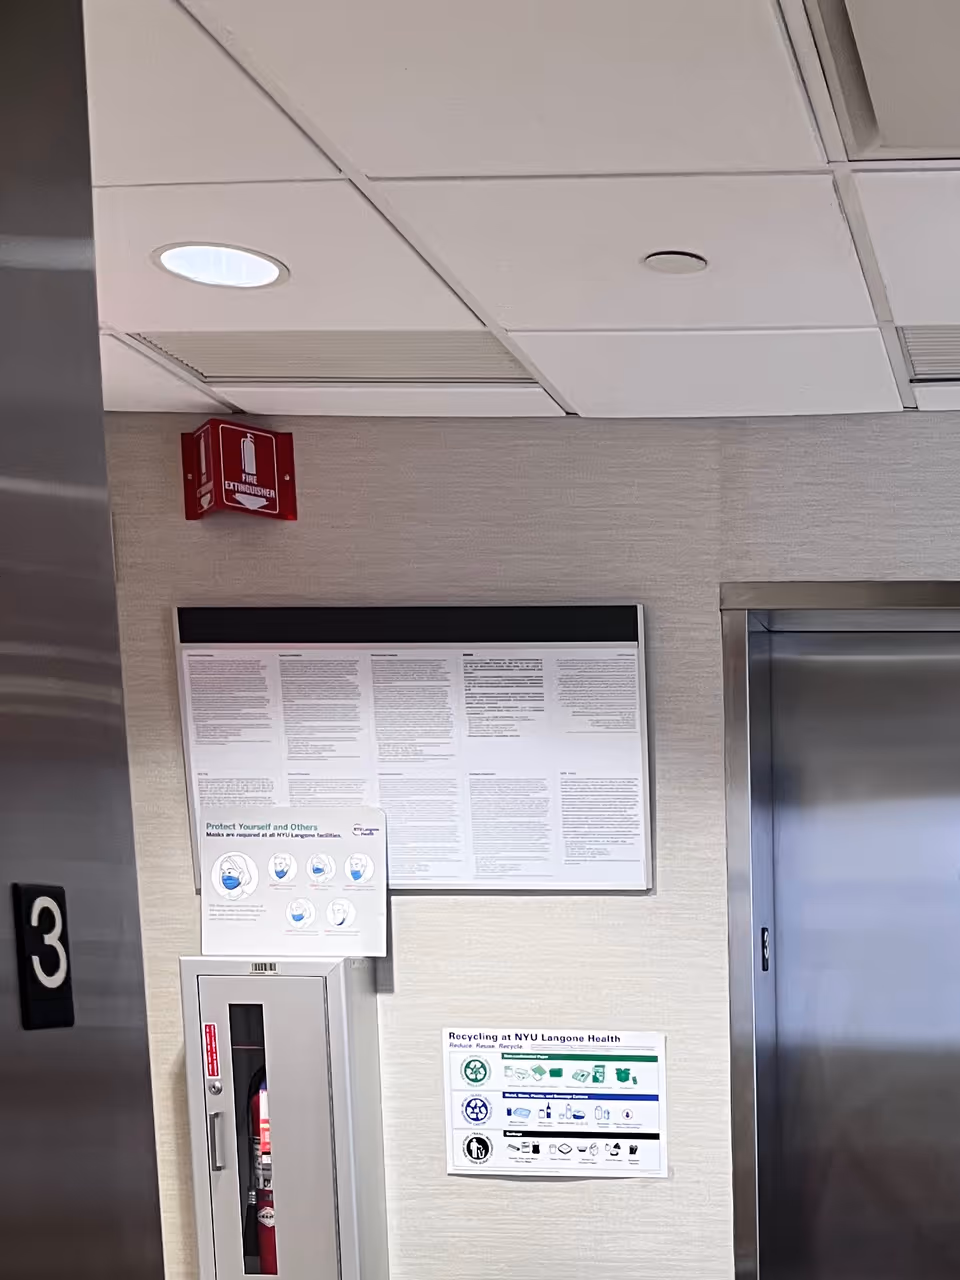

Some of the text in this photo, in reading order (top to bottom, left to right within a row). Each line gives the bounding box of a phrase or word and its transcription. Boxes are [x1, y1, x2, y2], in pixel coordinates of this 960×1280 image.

[242, 473, 258, 485] FIRE
[225, 481, 276, 499] EXTINGUISHER
[206, 822, 318, 832] Protect Yourself and Others
[31, 896, 68, 989] 3
[764, 931, 770, 959] 3
[449, 1032, 498, 1042] Recycling
[514, 1033, 538, 1042] NYU
[541, 1034, 585, 1043] Langone
[588, 1034, 621, 1043] Health
